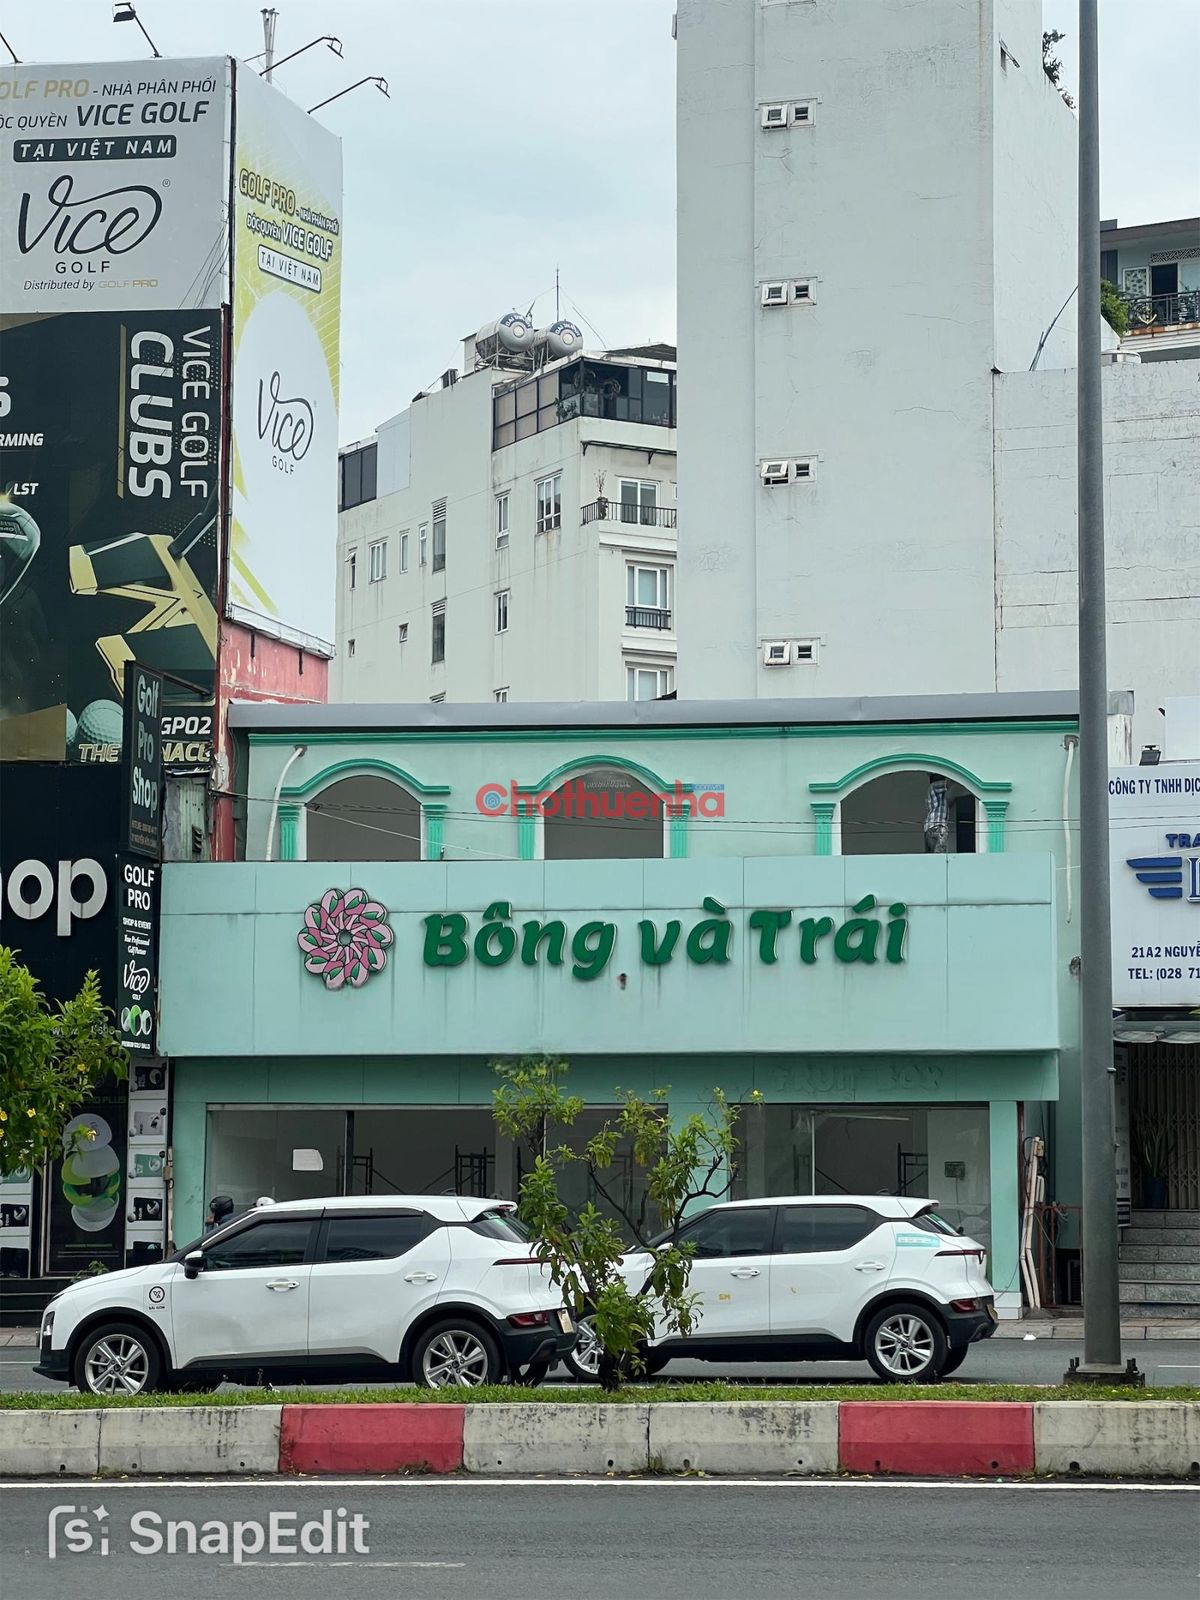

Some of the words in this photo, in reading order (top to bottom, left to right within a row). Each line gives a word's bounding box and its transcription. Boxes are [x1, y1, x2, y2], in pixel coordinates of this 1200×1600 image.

[44, 79, 89, 98] PRO
[102, 80, 132, 96] NHÀ
[137, 79, 178, 95] PHÂN
[181, 75, 216, 93] PHỐI
[17, 112, 68, 131] QUYỀN
[77, 103, 134, 127] VICE
[141, 101, 209, 123] GOLF
[21, 143, 54, 160] TẠI
[67, 139, 115, 158] VIỆT
[125, 140, 172, 154] NAM
[239, 168, 271, 204] GOLF
[271, 182, 296, 216] PRO
[18, 175, 162, 254] Vice
[247, 212, 260, 234] ĐỘC
[282, 220, 305, 251] VICE
[306, 232, 333, 261] GOLF
[55, 261, 110, 273] GOLF
[261, 251, 275, 269] TẠI
[279, 260, 298, 278] VIỆT
[301, 268, 319, 285] NAM
[24, 280, 80, 291] Distributed
[82, 281, 95, 292] by
[132, 279, 158, 288] PRO
[182, 326, 211, 400] VICE
[128, 330, 175, 499] CLUBS
[258, 371, 314, 460] Vice
[180, 411, 210, 497] GOLF
[271, 456, 295, 475] GOLF
[13, 483, 39, 495] LST
[137, 674, 159, 719] Golf
[79, 743, 120, 762] THE
[137, 720, 154, 763] Pro
[132, 766, 158, 818] Shop
[1108, 777, 1136, 795] CÔNG
[1138, 779, 1152, 794] TY
[1154, 778, 1182, 794] TNHH
[124, 864, 155, 887] GOLF
[0, 858, 107, 936] op
[128, 888, 150, 910] PRO
[422, 901, 618, 981] Bông
[638, 896, 733, 966] và
[750, 894, 910, 965] Trái
[1131, 946, 1162, 958] 21A2
[124, 960, 150, 993] Vice
[1128, 968, 1153, 979] TEL:
[1156, 968, 1182, 981] (028
[1188, 967, 1200, 979] 71
